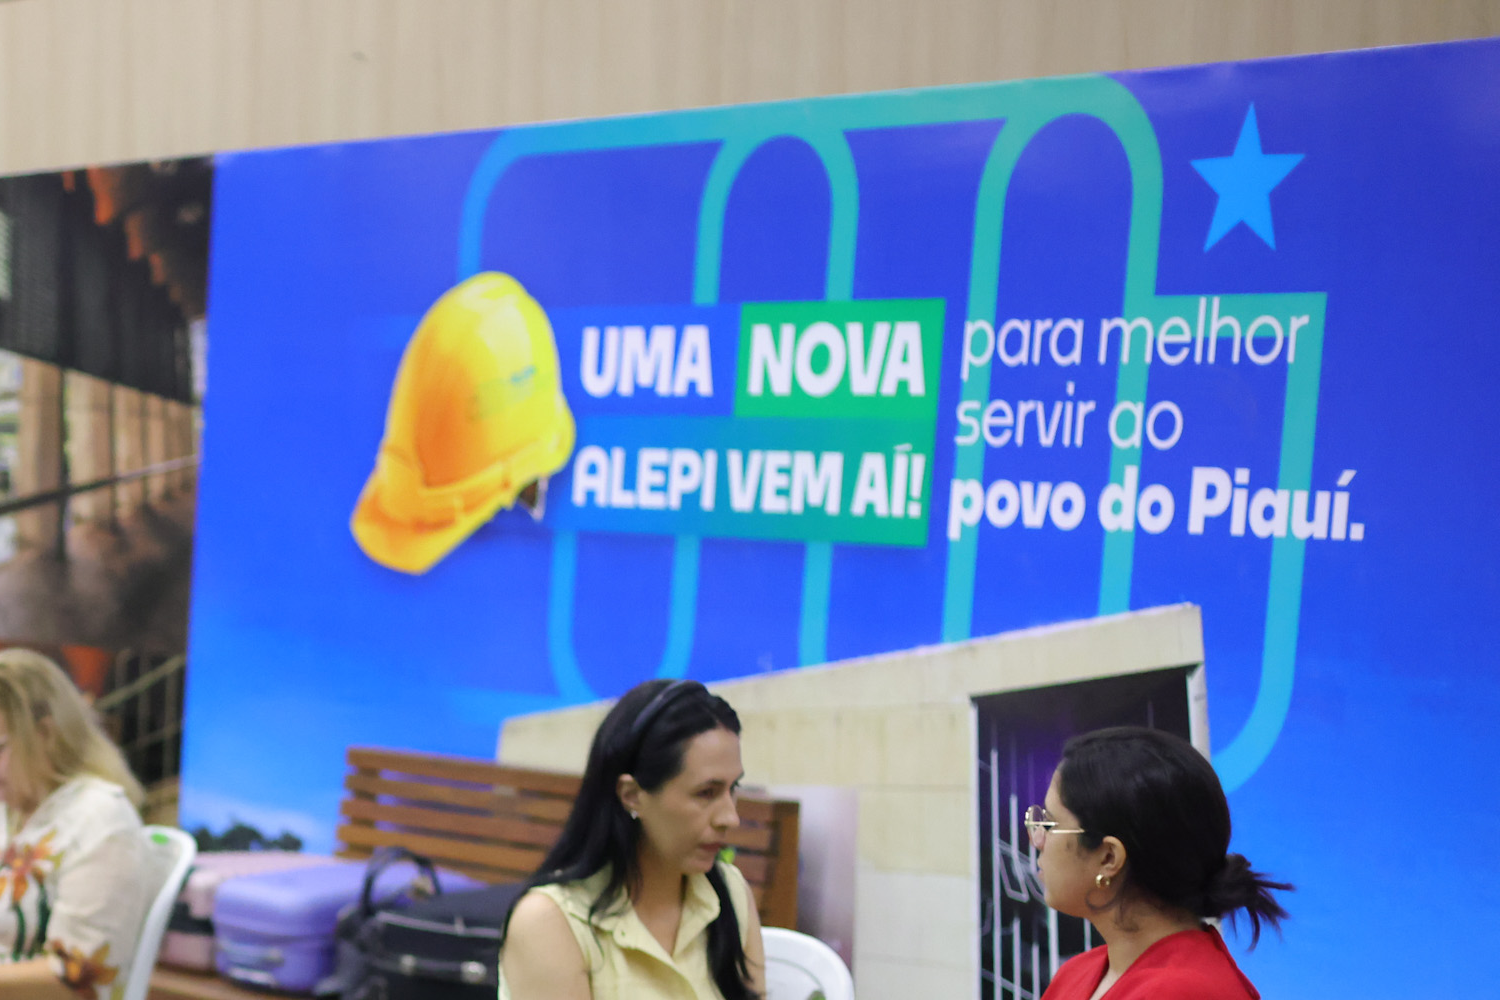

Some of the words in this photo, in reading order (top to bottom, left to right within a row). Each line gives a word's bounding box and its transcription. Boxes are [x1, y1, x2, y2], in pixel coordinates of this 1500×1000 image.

[580, 324, 714, 398] UMA
[746, 321, 926, 397] NOVA
[960, 317, 1085, 382] para
[1098, 296, 1310, 366] melhor
[953, 381, 1097, 448] servir
[1108, 400, 1184, 450] ao
[572, 444, 718, 512] ALEPI
[726, 449, 845, 516] VEM
[850, 443, 927, 518] AÍ!
[946, 478, 1087, 541] povo
[1097, 464, 1176, 534] do
[1187, 466, 1366, 541] Piauí.
